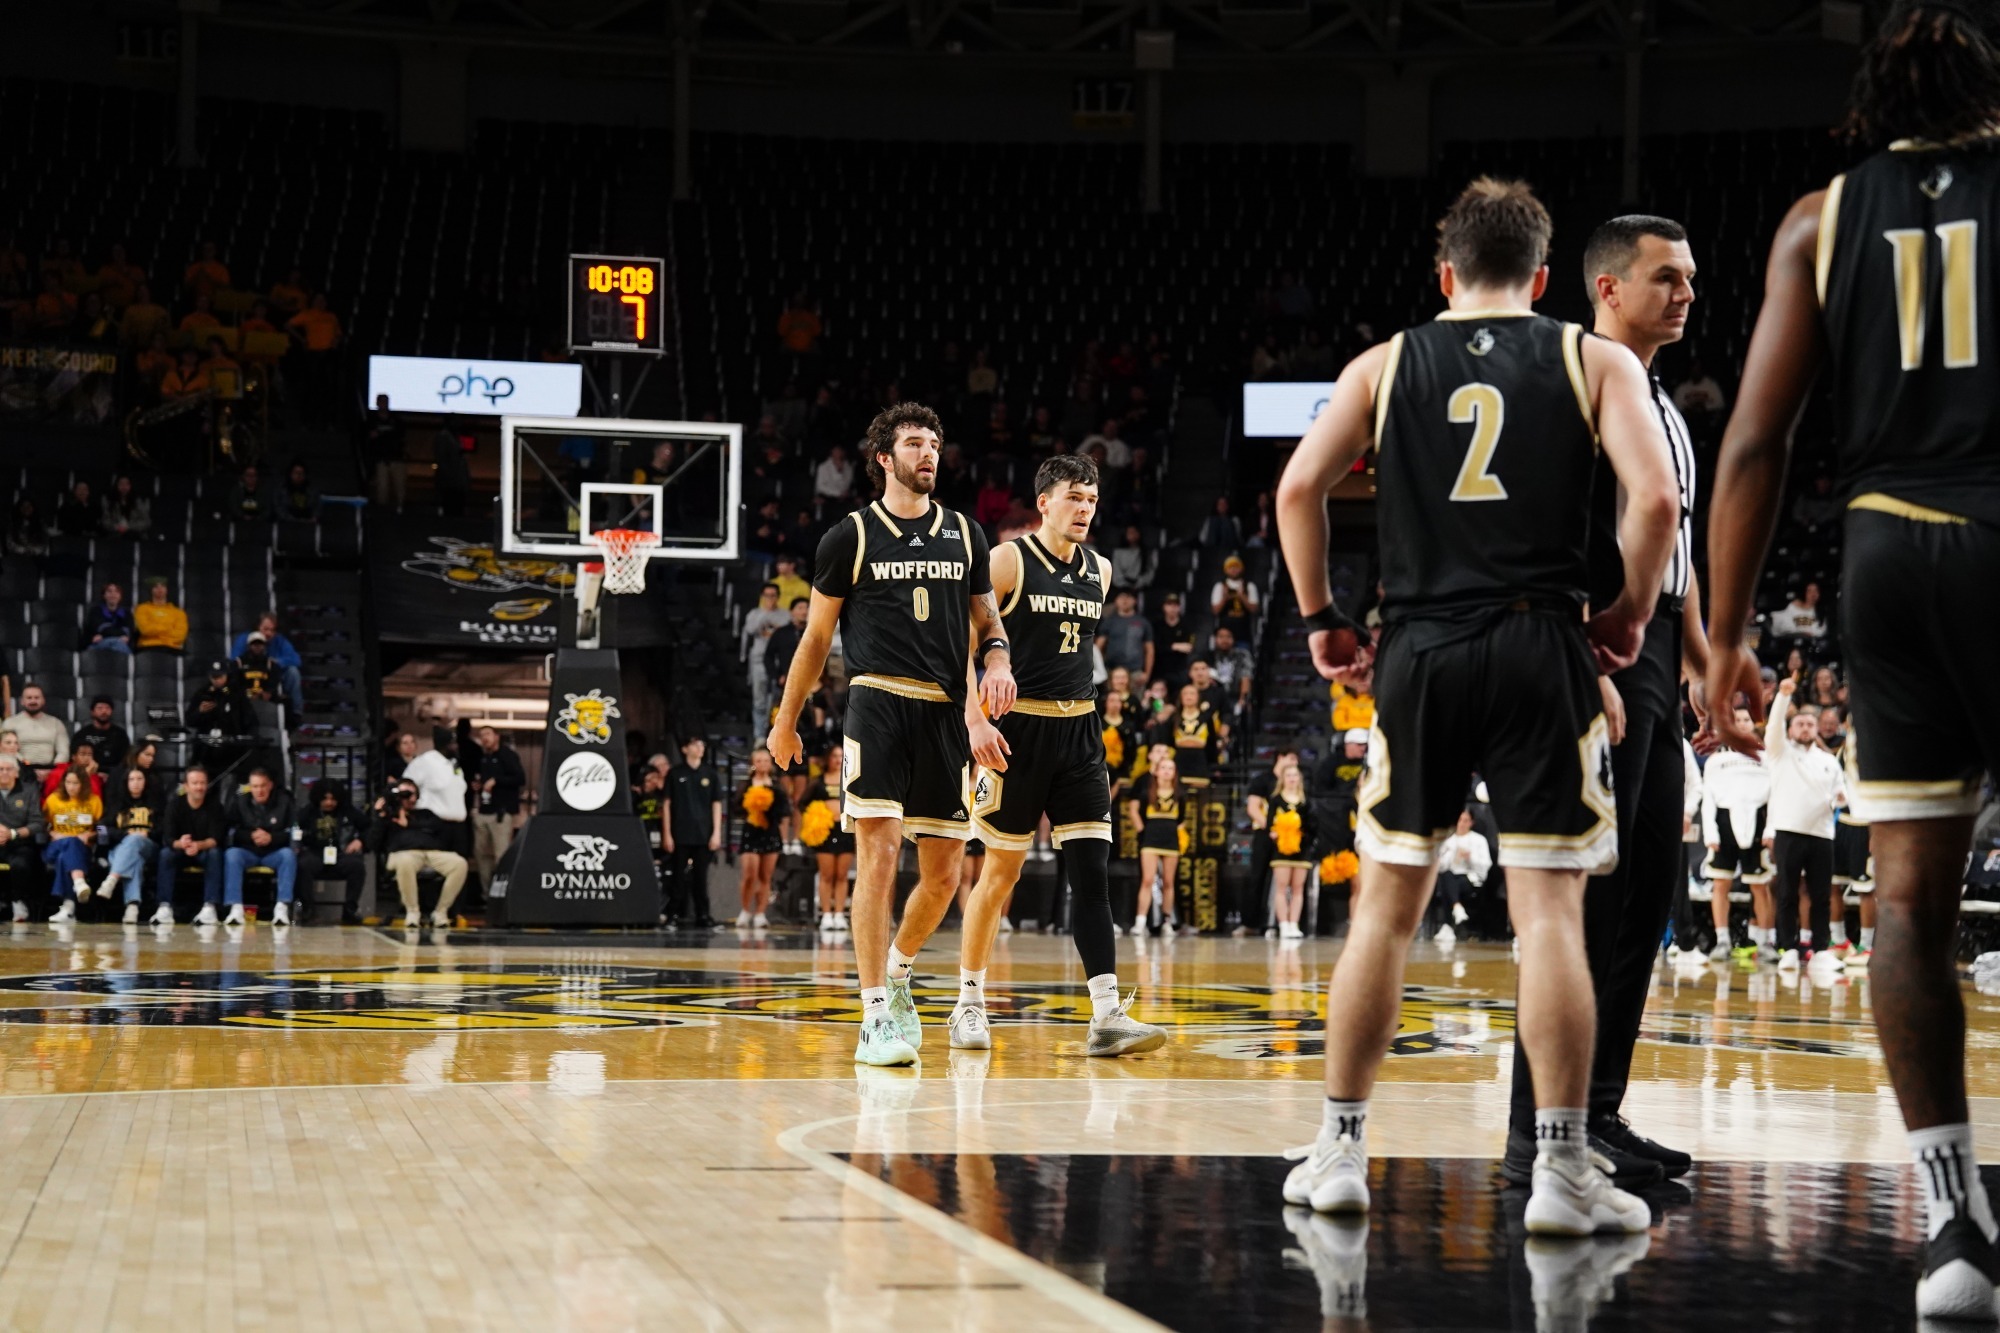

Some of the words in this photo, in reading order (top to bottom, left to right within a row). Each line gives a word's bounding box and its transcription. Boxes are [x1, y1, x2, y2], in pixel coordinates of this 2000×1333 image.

[1076, 80, 1134, 113] 117
[588, 265, 654, 294] 10:08
[1882, 218, 1979, 371] 11
[620, 295, 645, 340] 7
[437, 366, 515, 406] php
[1447, 382, 1509, 501] 2
[869, 560, 965, 581] WOFFORD
[912, 586, 930, 622] 0
[1027, 594, 1104, 620] WOFFORD
[540, 872, 632, 890] DYNAMO
[553, 890, 615, 900] CAPITAL
